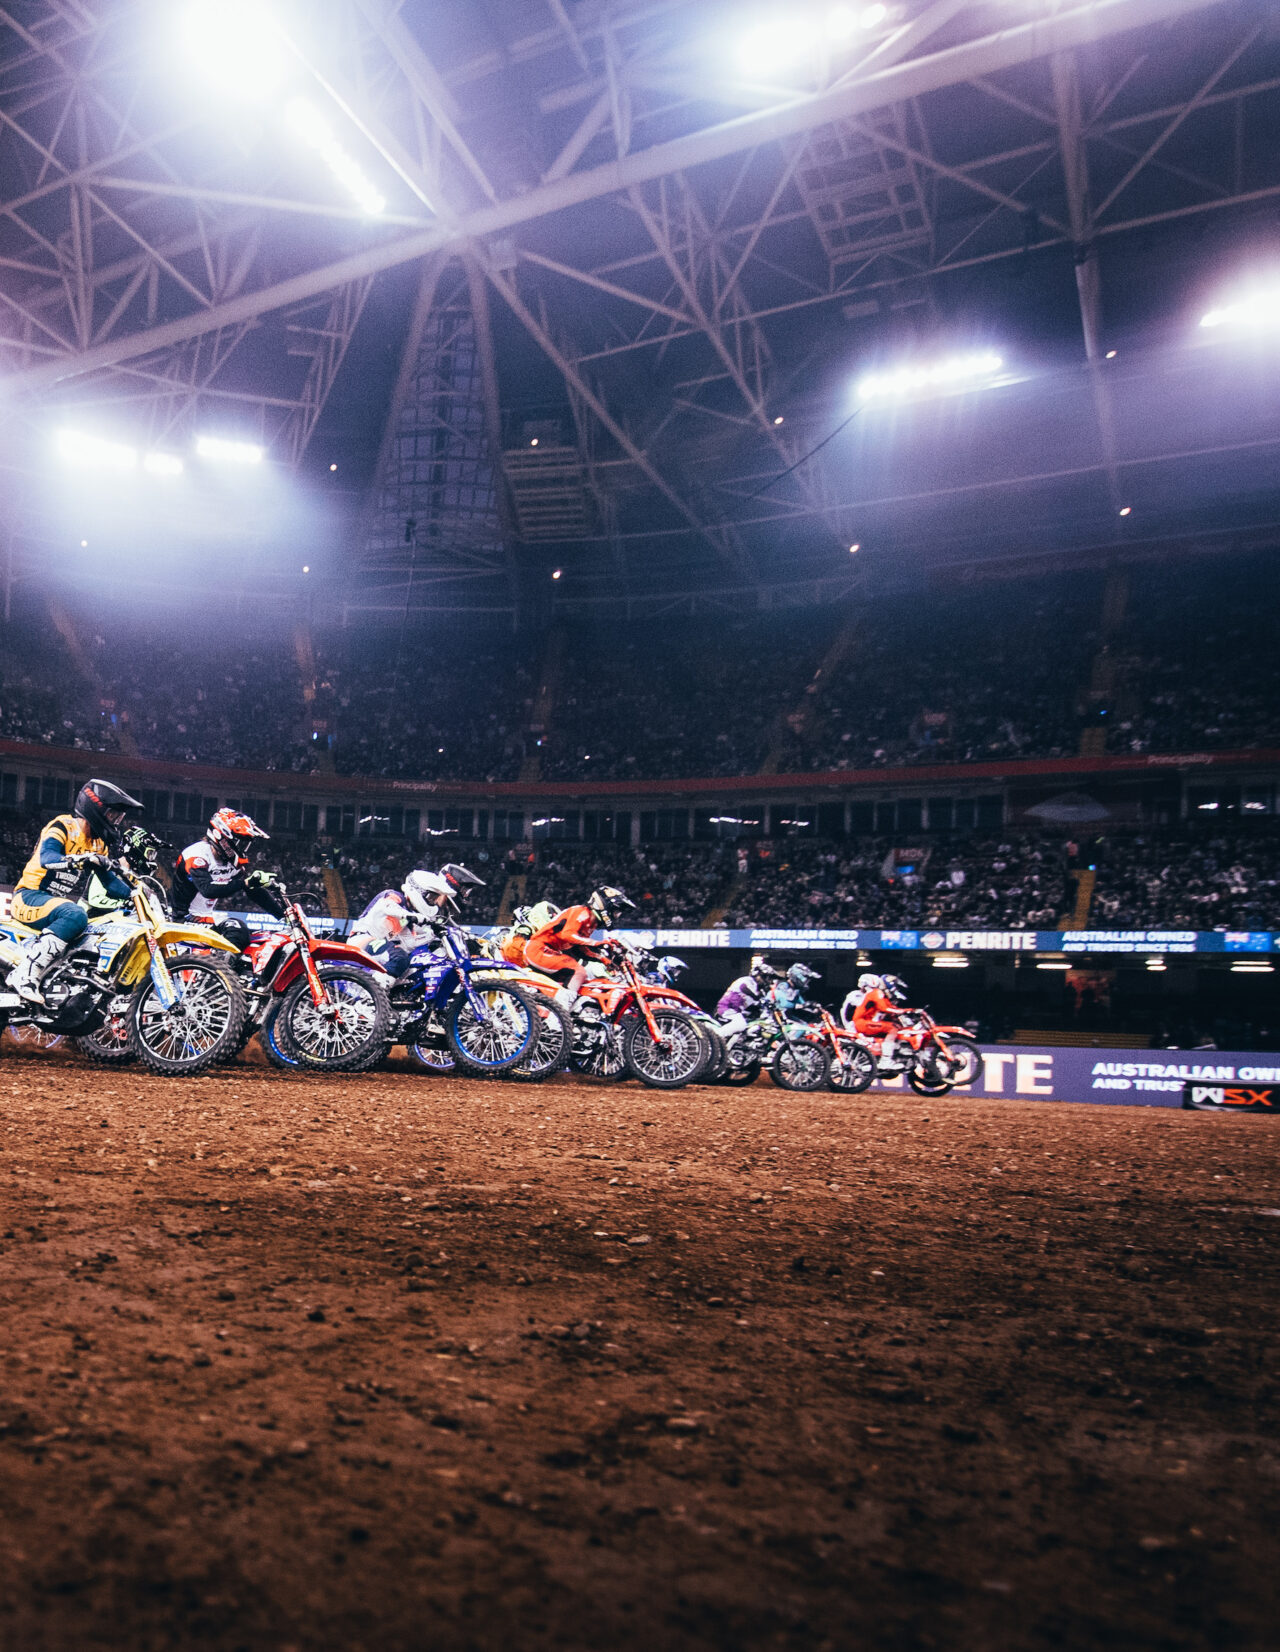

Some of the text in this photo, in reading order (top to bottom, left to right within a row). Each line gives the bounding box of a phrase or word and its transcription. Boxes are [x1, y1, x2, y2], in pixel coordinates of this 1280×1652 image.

[656, 930, 730, 946] PENRITE
[750, 929, 859, 940] AUSTRALIAN OWNED
[946, 932, 1037, 949] PENRITE
[1062, 931, 1198, 941] AUSTRALIAN OWNED
[1062, 943, 1086, 951] AND
[1086, 943, 1135, 952] TRUSTED
[1135, 943, 1168, 952] SINCE
[1092, 1062, 1234, 1080] AUSTRALIAN
[1092, 1078, 1187, 1092] AND TRUS
[1191, 1085, 1273, 1107] WSX
